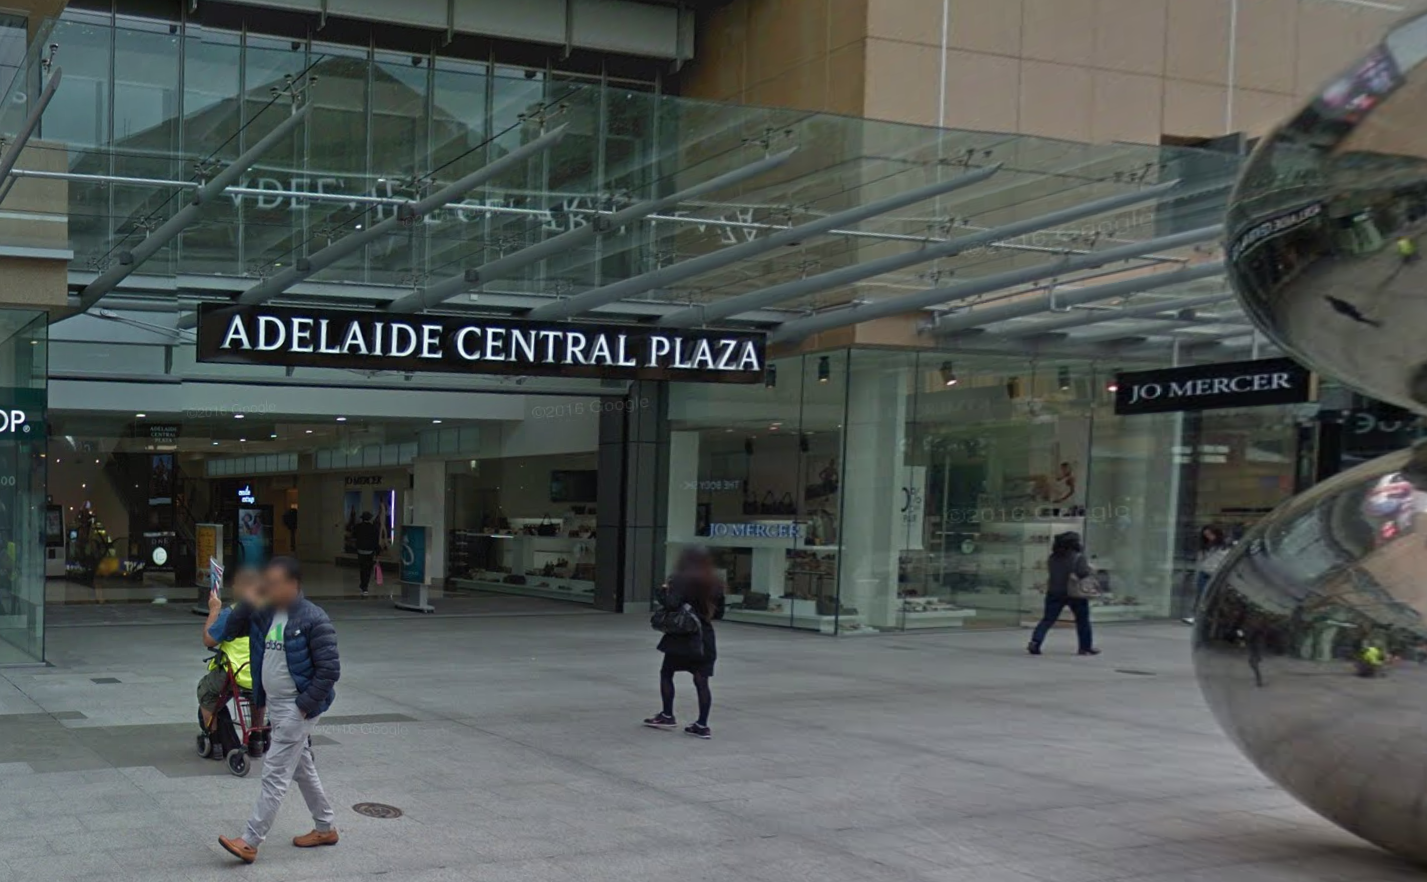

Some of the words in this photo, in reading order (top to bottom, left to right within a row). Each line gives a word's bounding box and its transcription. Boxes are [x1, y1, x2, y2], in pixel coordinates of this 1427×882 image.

[219, 312, 444, 359] ADELAIDE
[455, 325, 638, 368] CENTRAL
[643, 334, 762, 372] PLAZA
[1128, 383, 1161, 404] JO
[1168, 372, 1293, 398] MERCER
[709, 523, 728, 540] JO
[729, 522, 802, 539] MERCER
